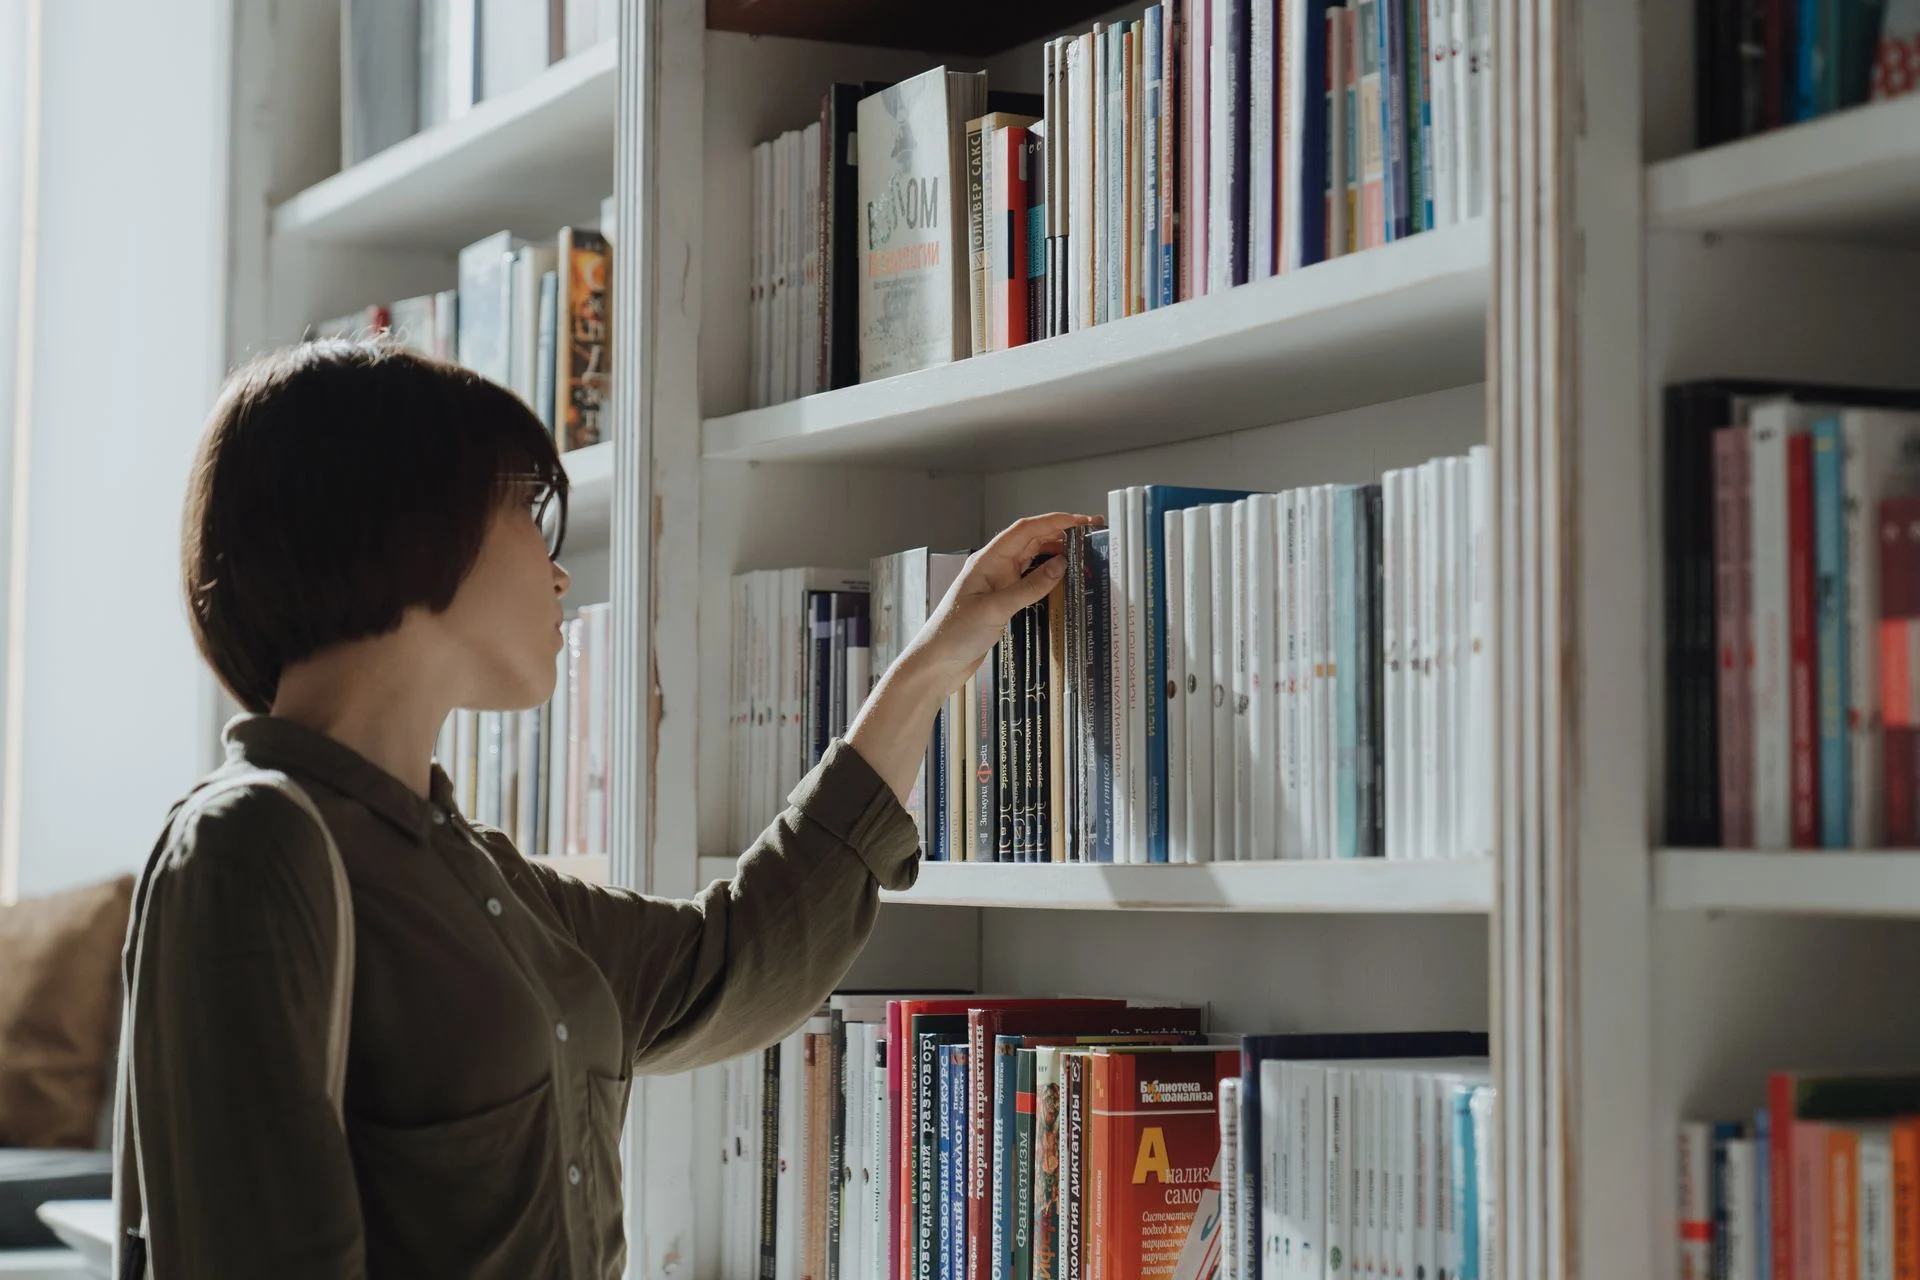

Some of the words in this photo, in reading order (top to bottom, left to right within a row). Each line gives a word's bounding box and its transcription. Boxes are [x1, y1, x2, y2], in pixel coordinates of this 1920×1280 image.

[971, 136, 981, 176] САКС
[972, 183, 983, 245] ОЛИВЕР
[1113, 639, 1122, 778] ИНДИВИДУАЛЬНАЯ
[976, 744, 992, 784] Фрейд
[1001, 763, 1009, 790] Эрих
[979, 786, 989, 826] Зигмунд
[922, 1039, 935, 1134] разговор
[940, 1055, 949, 1140] ДИСКУРС
[976, 1024, 987, 1114] практики
[1140, 1080, 1200, 1093] Библиотека
[1142, 1092, 1214, 1103] психоанализа
[976, 1118, 985, 1130] и
[1069, 1094, 1081, 1197] диктатуры
[954, 1120, 964, 1197] ДИАЛОГ
[976, 1134, 987, 1200] теории
[1132, 1127, 1210, 1184] Анализ
[1015, 1131, 1029, 1248] Фанатизм
[1165, 1188, 1202, 1204] само
[1142, 1223, 1167, 1236] подход
